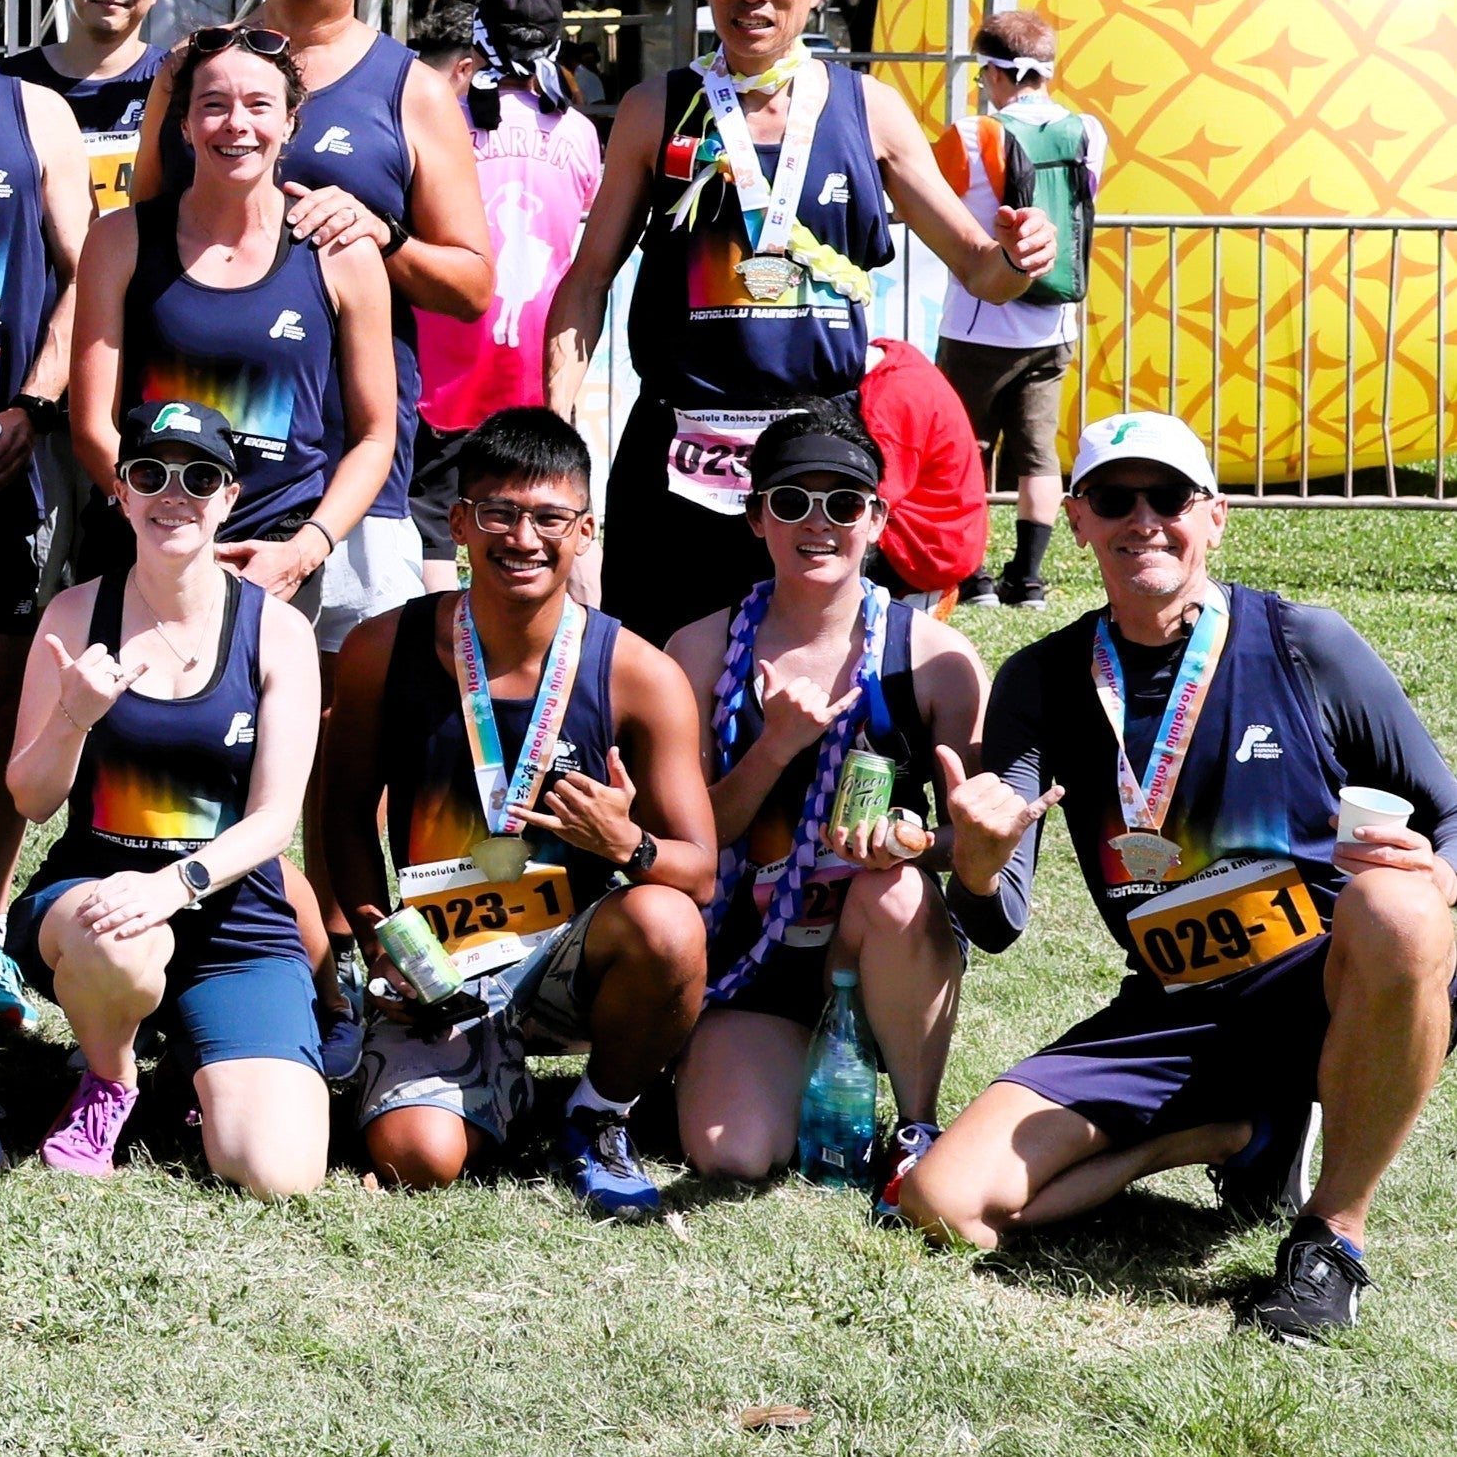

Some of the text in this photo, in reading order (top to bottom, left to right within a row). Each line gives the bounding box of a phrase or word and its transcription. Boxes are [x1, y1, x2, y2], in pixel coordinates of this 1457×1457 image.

[723, 414, 767, 422] Rainbow
[461, 627, 480, 693] Honolulu
[550, 628, 573, 691] Honolulu
[529, 696, 559, 761] Rainbow
[1166, 681, 1198, 749] Honolulu
[854, 790, 885, 809] Tea
[411, 865, 456, 880] Honolulu
[417, 880, 561, 944] 023-1
[1143, 887, 1307, 975] 029-1
